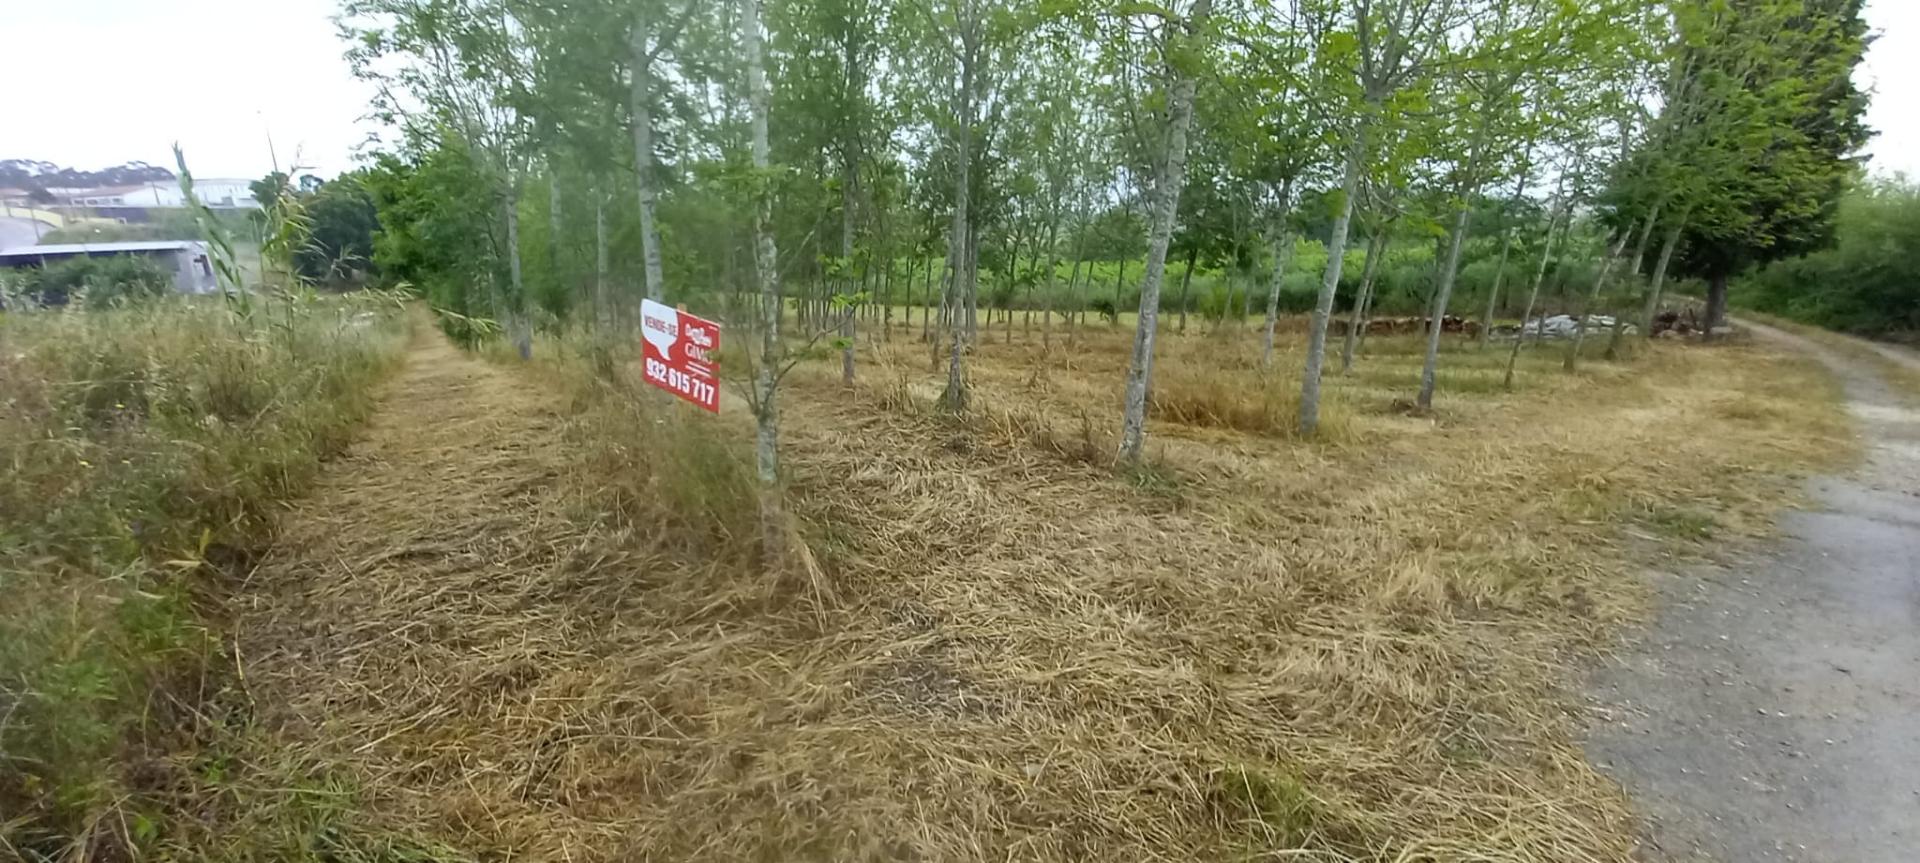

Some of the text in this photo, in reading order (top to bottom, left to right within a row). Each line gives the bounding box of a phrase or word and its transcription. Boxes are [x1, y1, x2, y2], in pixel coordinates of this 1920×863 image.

[644, 315, 678, 337] VENDE-SE
[646, 357, 667, 383] 932
[668, 368, 690, 394] 615
[692, 379, 714, 405] 717
